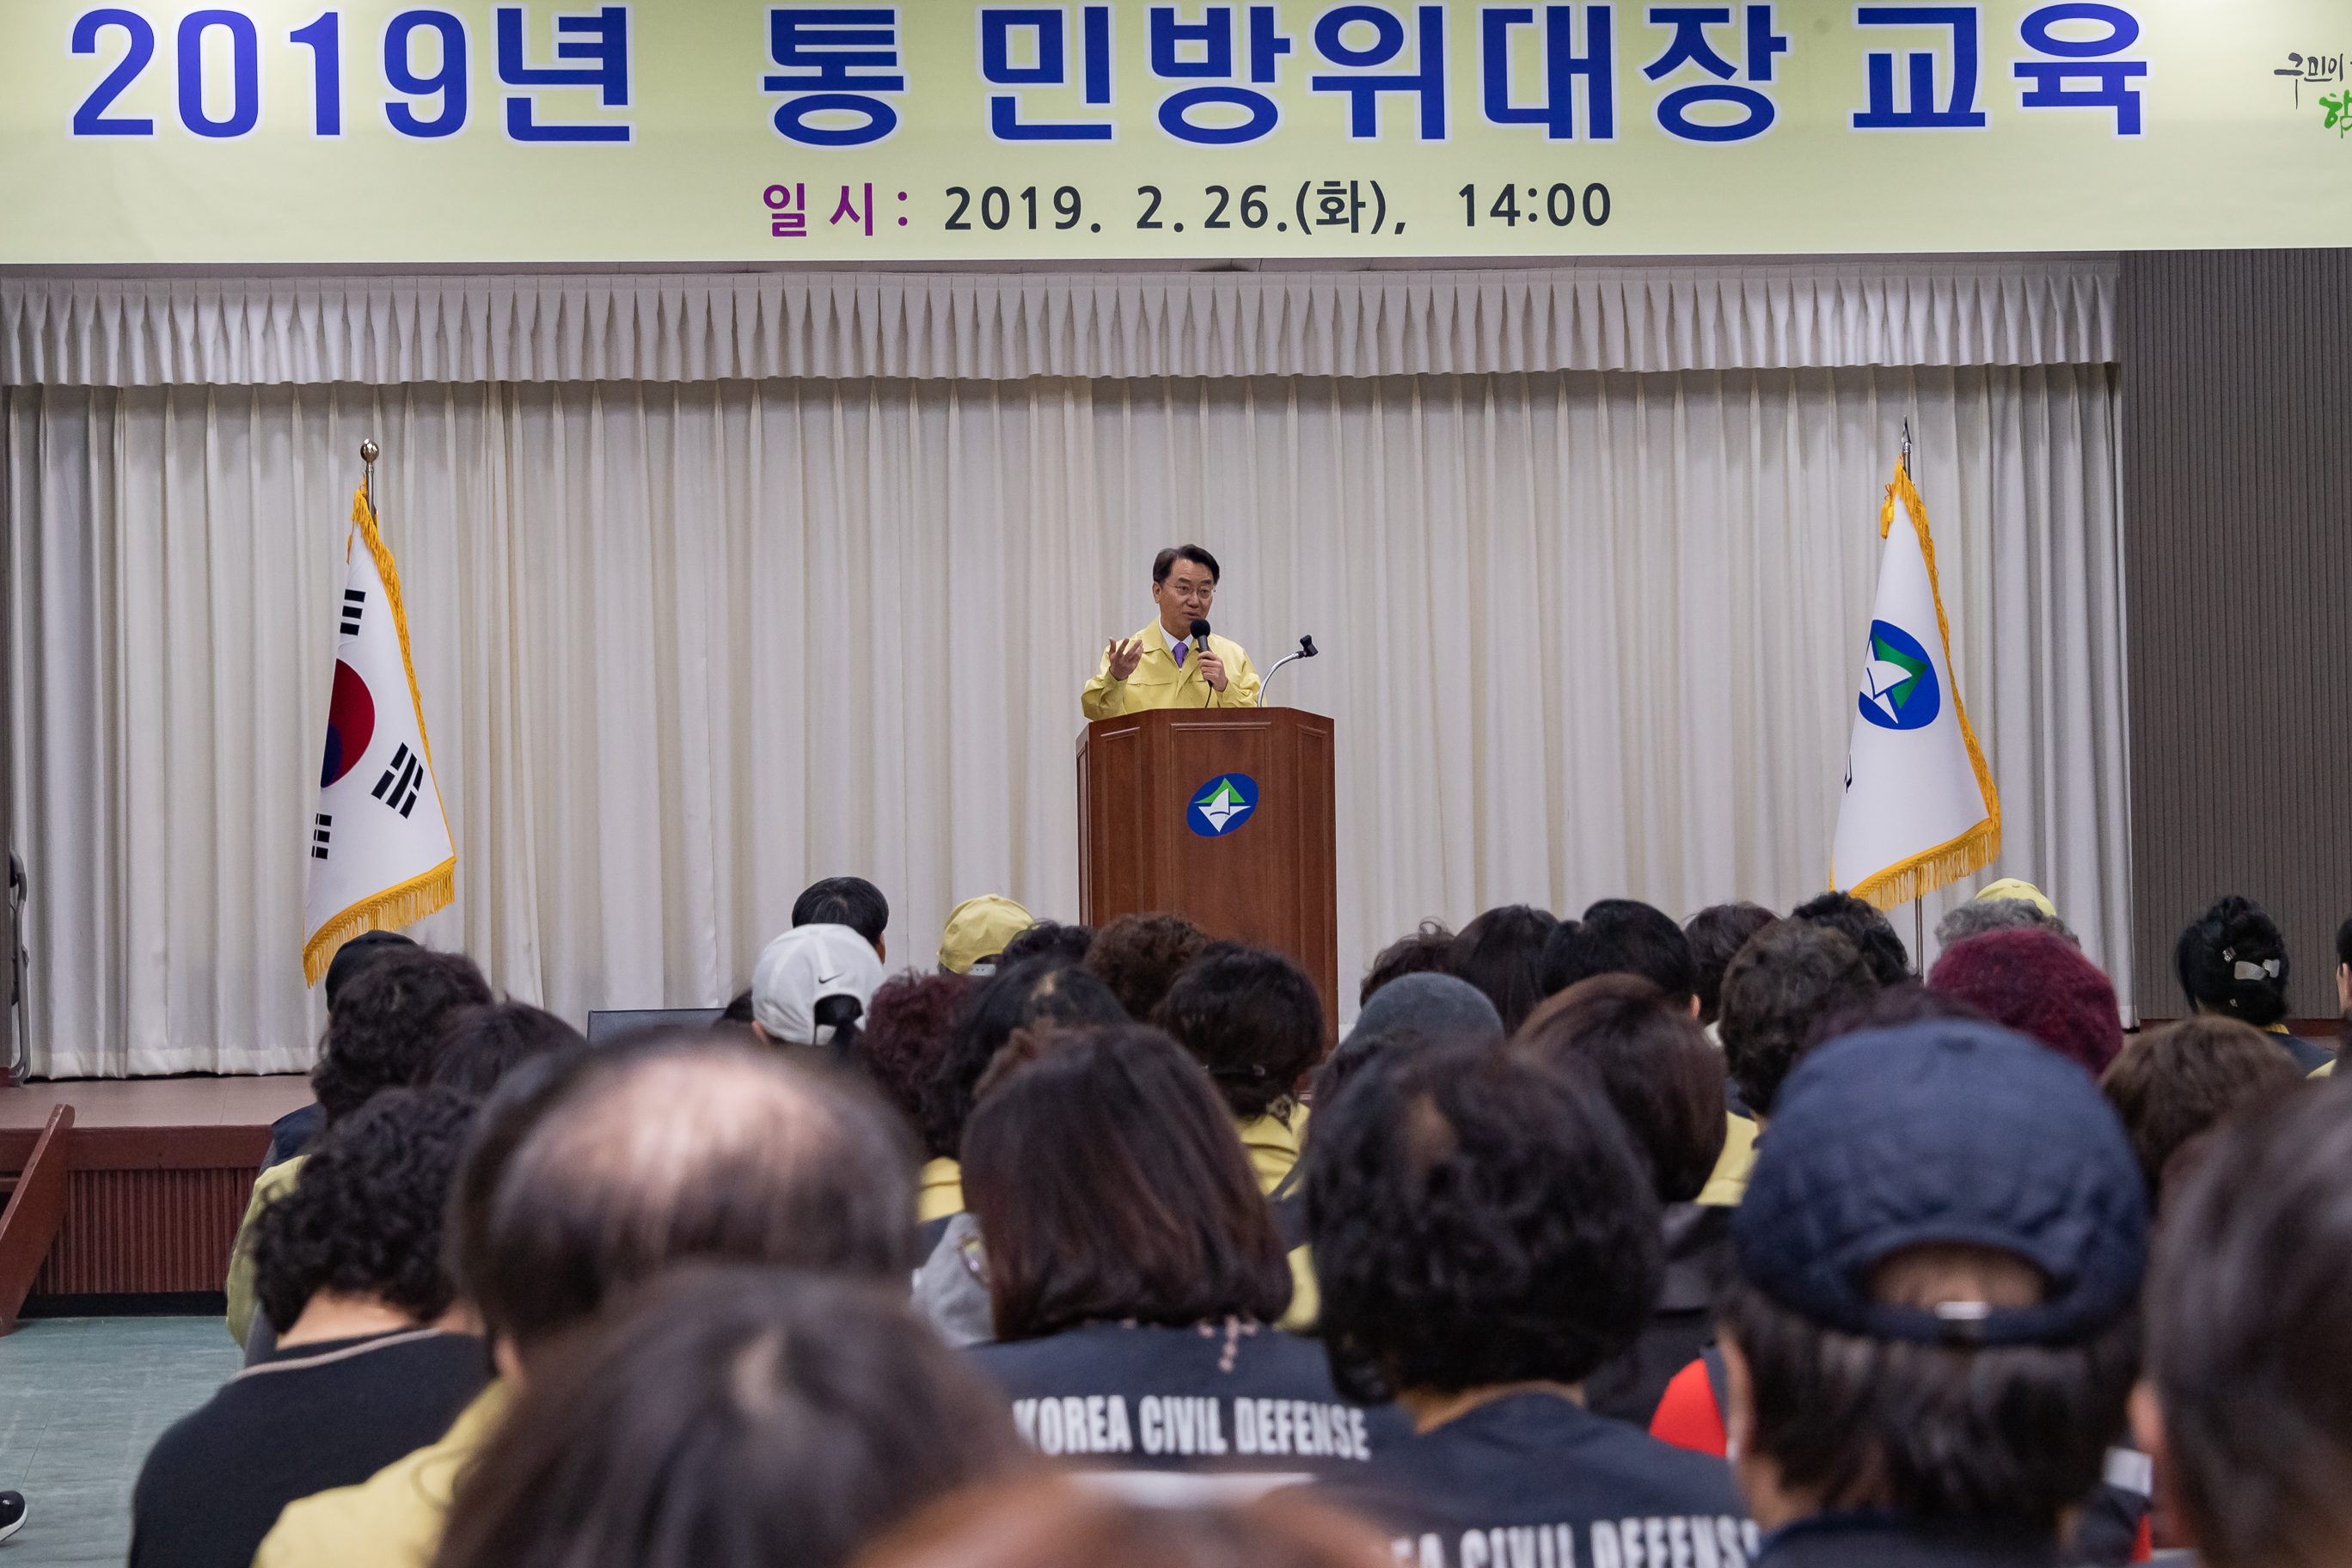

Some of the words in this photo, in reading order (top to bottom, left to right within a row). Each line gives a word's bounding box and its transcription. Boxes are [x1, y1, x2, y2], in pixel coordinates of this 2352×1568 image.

[71, 6, 631, 142] 2019년
[763, 9, 904, 147] 통
[982, 5, 1788, 145] 민방위대장
[1853, 3, 2147, 136] 교육
[1458, 182, 1611, 227] 14:00
[1139, 1396, 1228, 1455] CIVIL
[1234, 1397, 1372, 1461] DEFENSE
